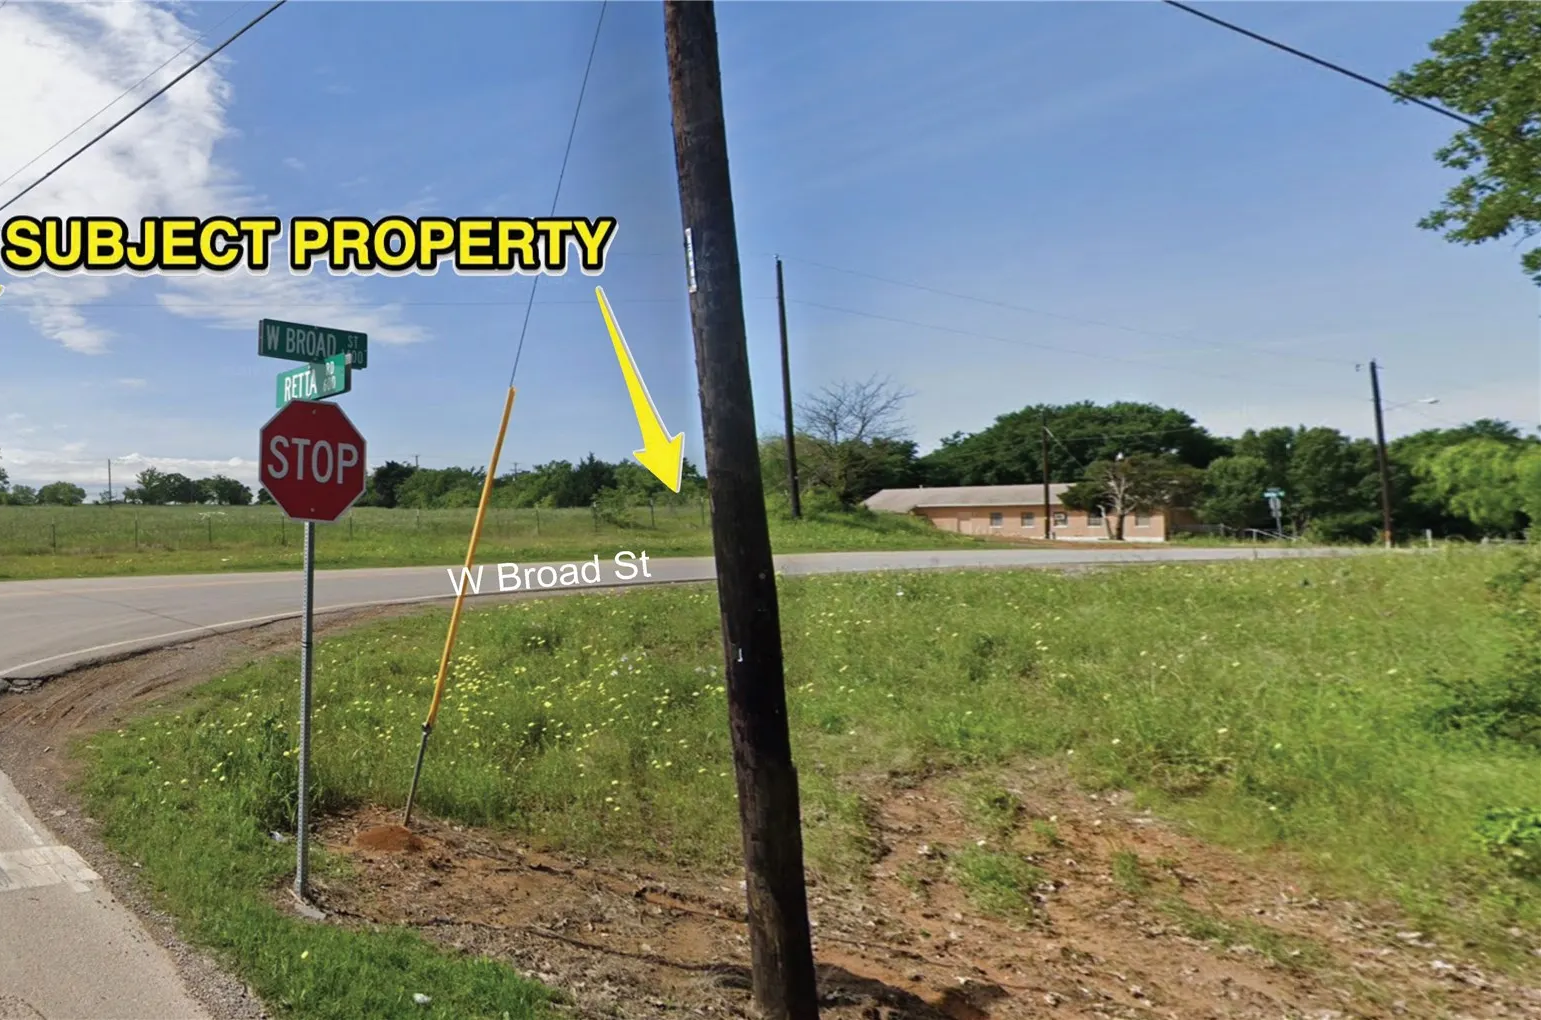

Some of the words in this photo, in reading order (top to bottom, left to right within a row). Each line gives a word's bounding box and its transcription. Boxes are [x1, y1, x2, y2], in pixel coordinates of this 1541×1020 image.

[266, 325, 280, 351] W
[286, 327, 337, 358] BROAD
[347, 335, 359, 349] ST
[283, 368, 318, 402] RETTA
[325, 361, 335, 376] RD
[267, 435, 359, 484] STOP
